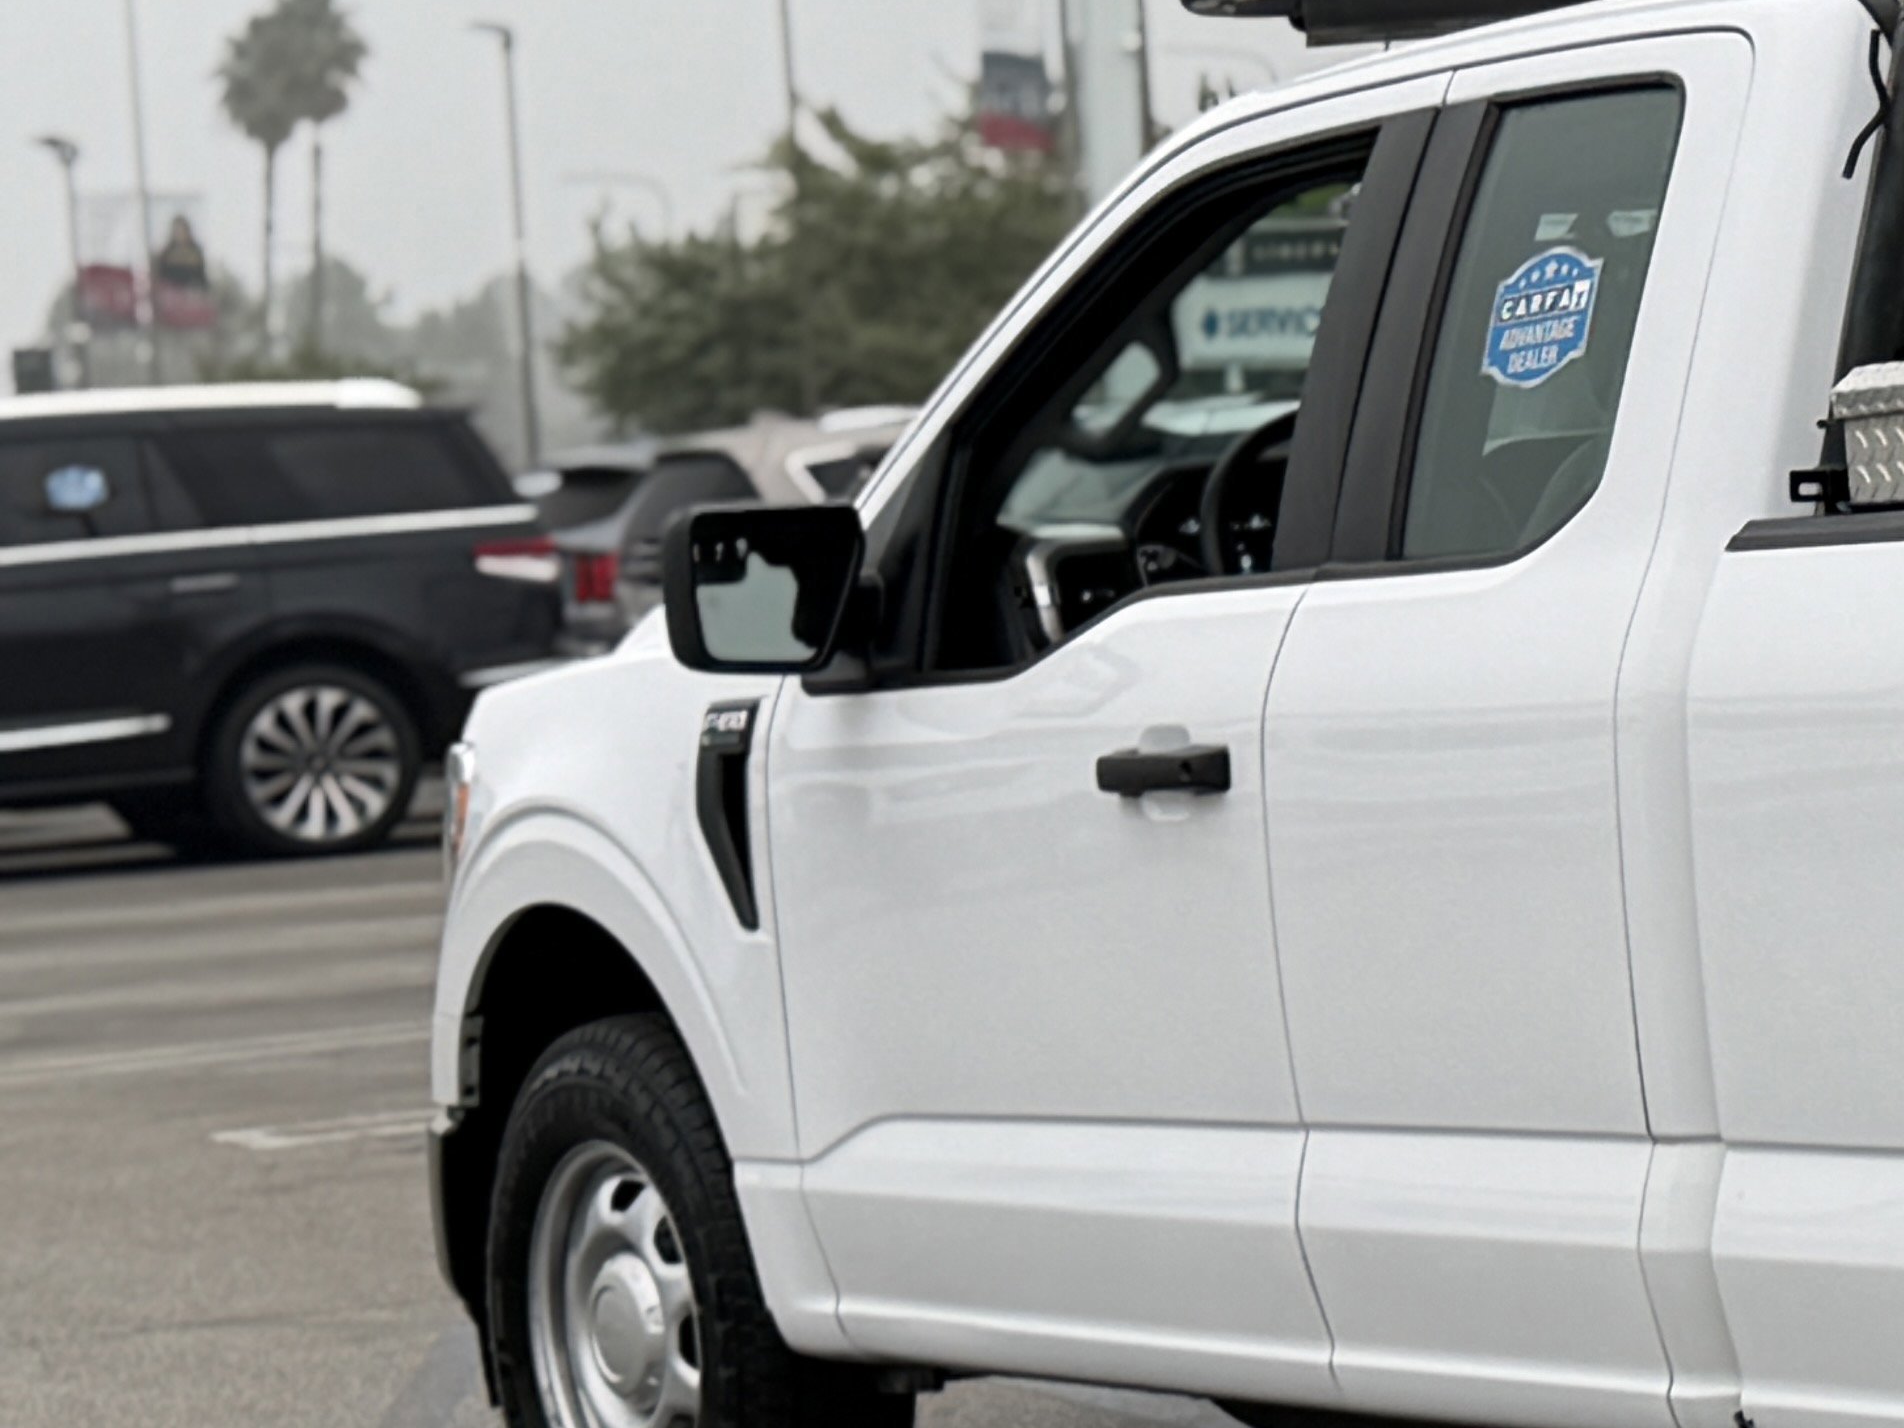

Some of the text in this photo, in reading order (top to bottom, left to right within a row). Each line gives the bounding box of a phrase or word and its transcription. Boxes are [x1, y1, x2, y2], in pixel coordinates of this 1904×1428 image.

[1228, 306, 1321, 338] SERVIC
[1500, 320, 1577, 351] ADVANTAGE
[1506, 347, 1558, 374] DEALER
